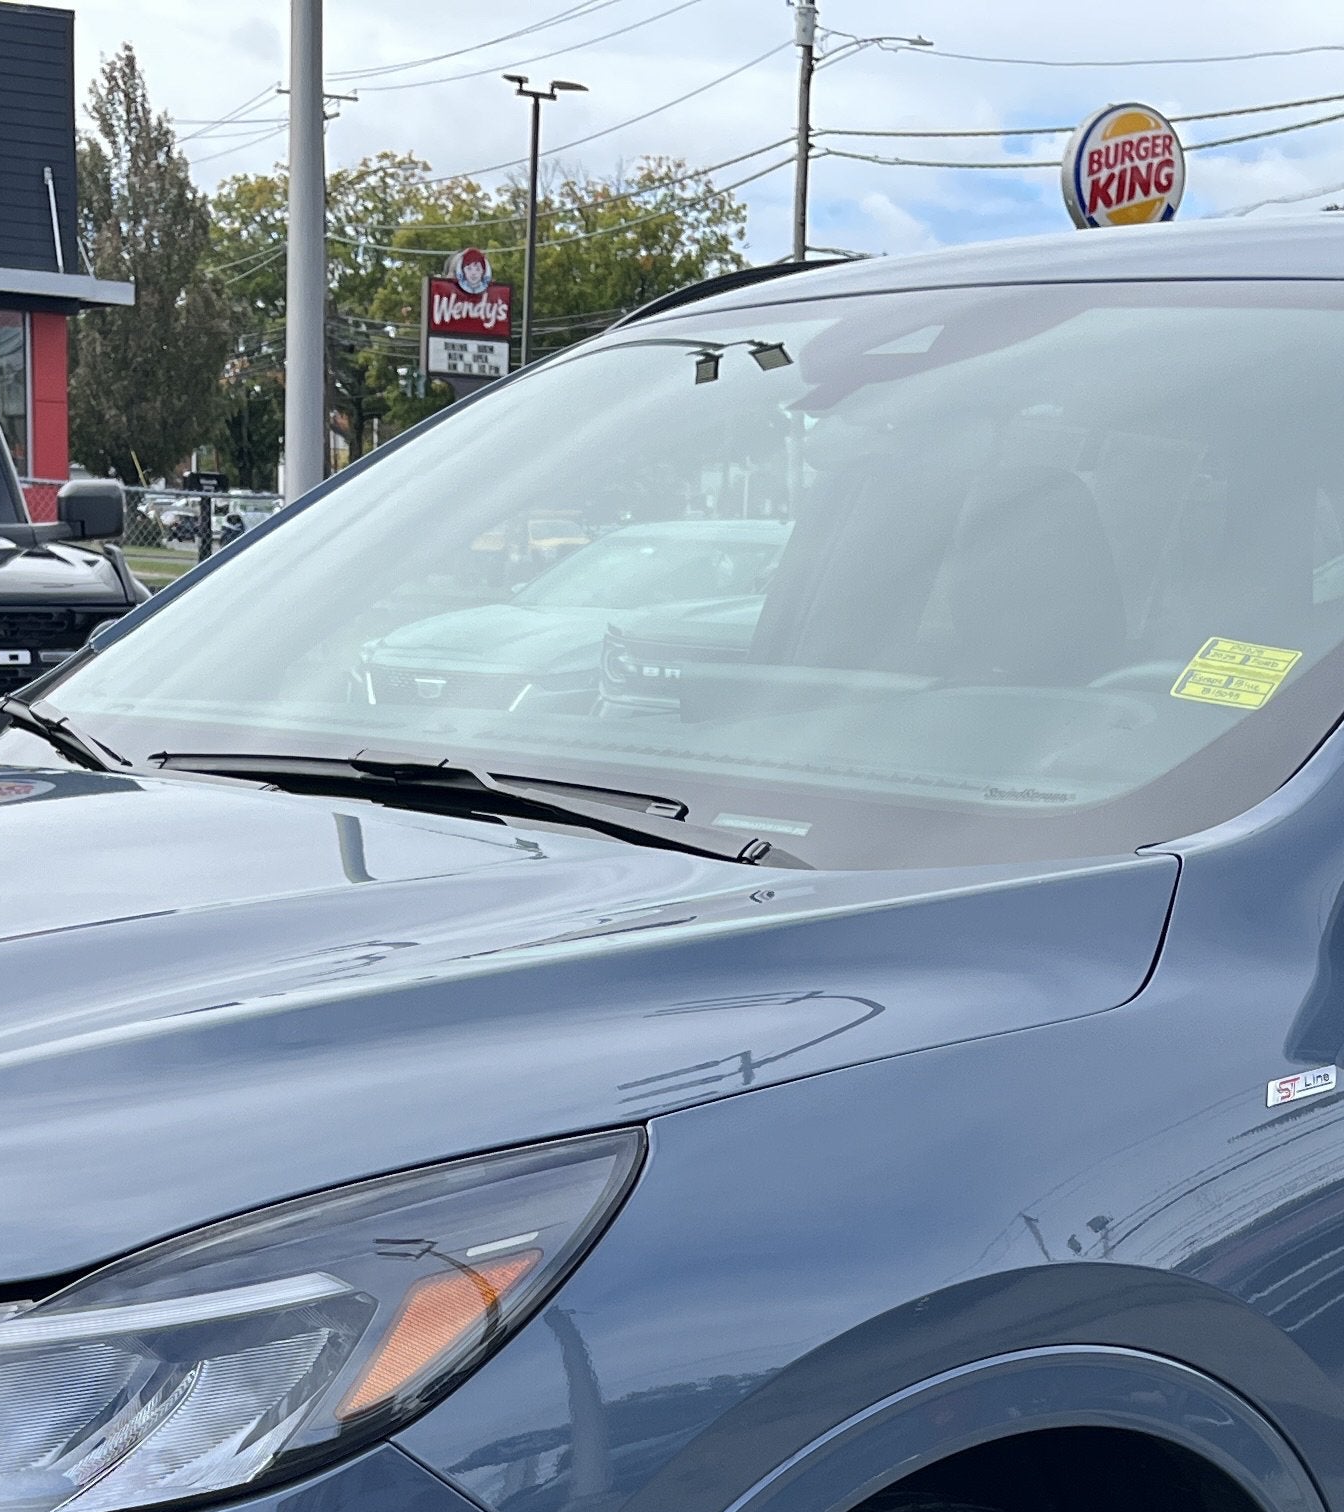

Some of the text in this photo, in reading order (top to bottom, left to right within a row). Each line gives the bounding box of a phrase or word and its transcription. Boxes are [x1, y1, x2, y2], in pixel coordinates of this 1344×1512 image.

[1088, 134, 1173, 177] BURGER
[1088, 159, 1175, 214] KING
[433, 293, 508, 328] Wendy's
[1277, 1073, 1330, 1101] ST Line
